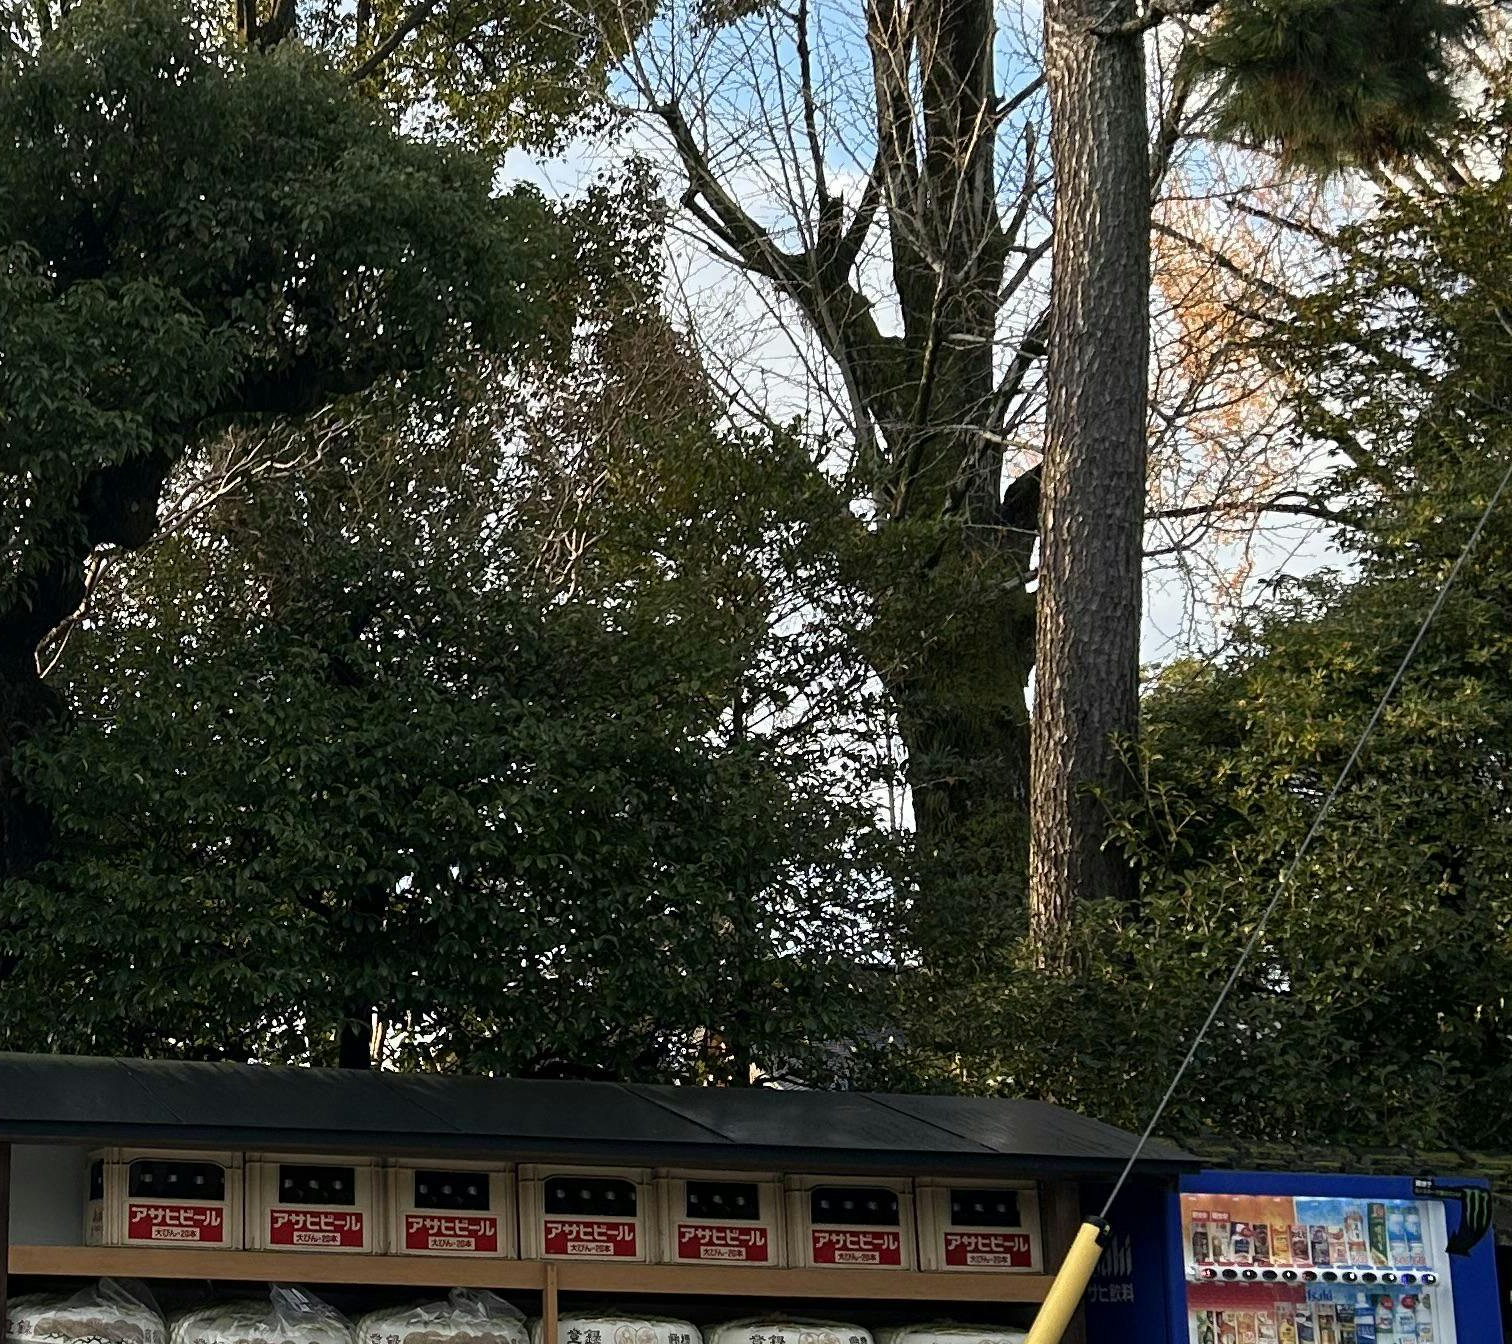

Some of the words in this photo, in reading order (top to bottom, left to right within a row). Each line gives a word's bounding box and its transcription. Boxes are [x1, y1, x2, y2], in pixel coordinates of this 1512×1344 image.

[131, 1207, 220, 1226] アサヒビール
[272, 1212, 360, 1231] アサヒビール
[408, 1218, 495, 1236] アサヒビール
[547, 1223, 634, 1241] アサヒビール
[680, 1227, 765, 1245] アサヒビール
[814, 1232, 898, 1250] アサヒビール
[946, 1235, 1028, 1253] アサヒビール
[1088, 1283, 1134, 1303] サヒ飲料
[567, 1328, 601, 1344] 登録
